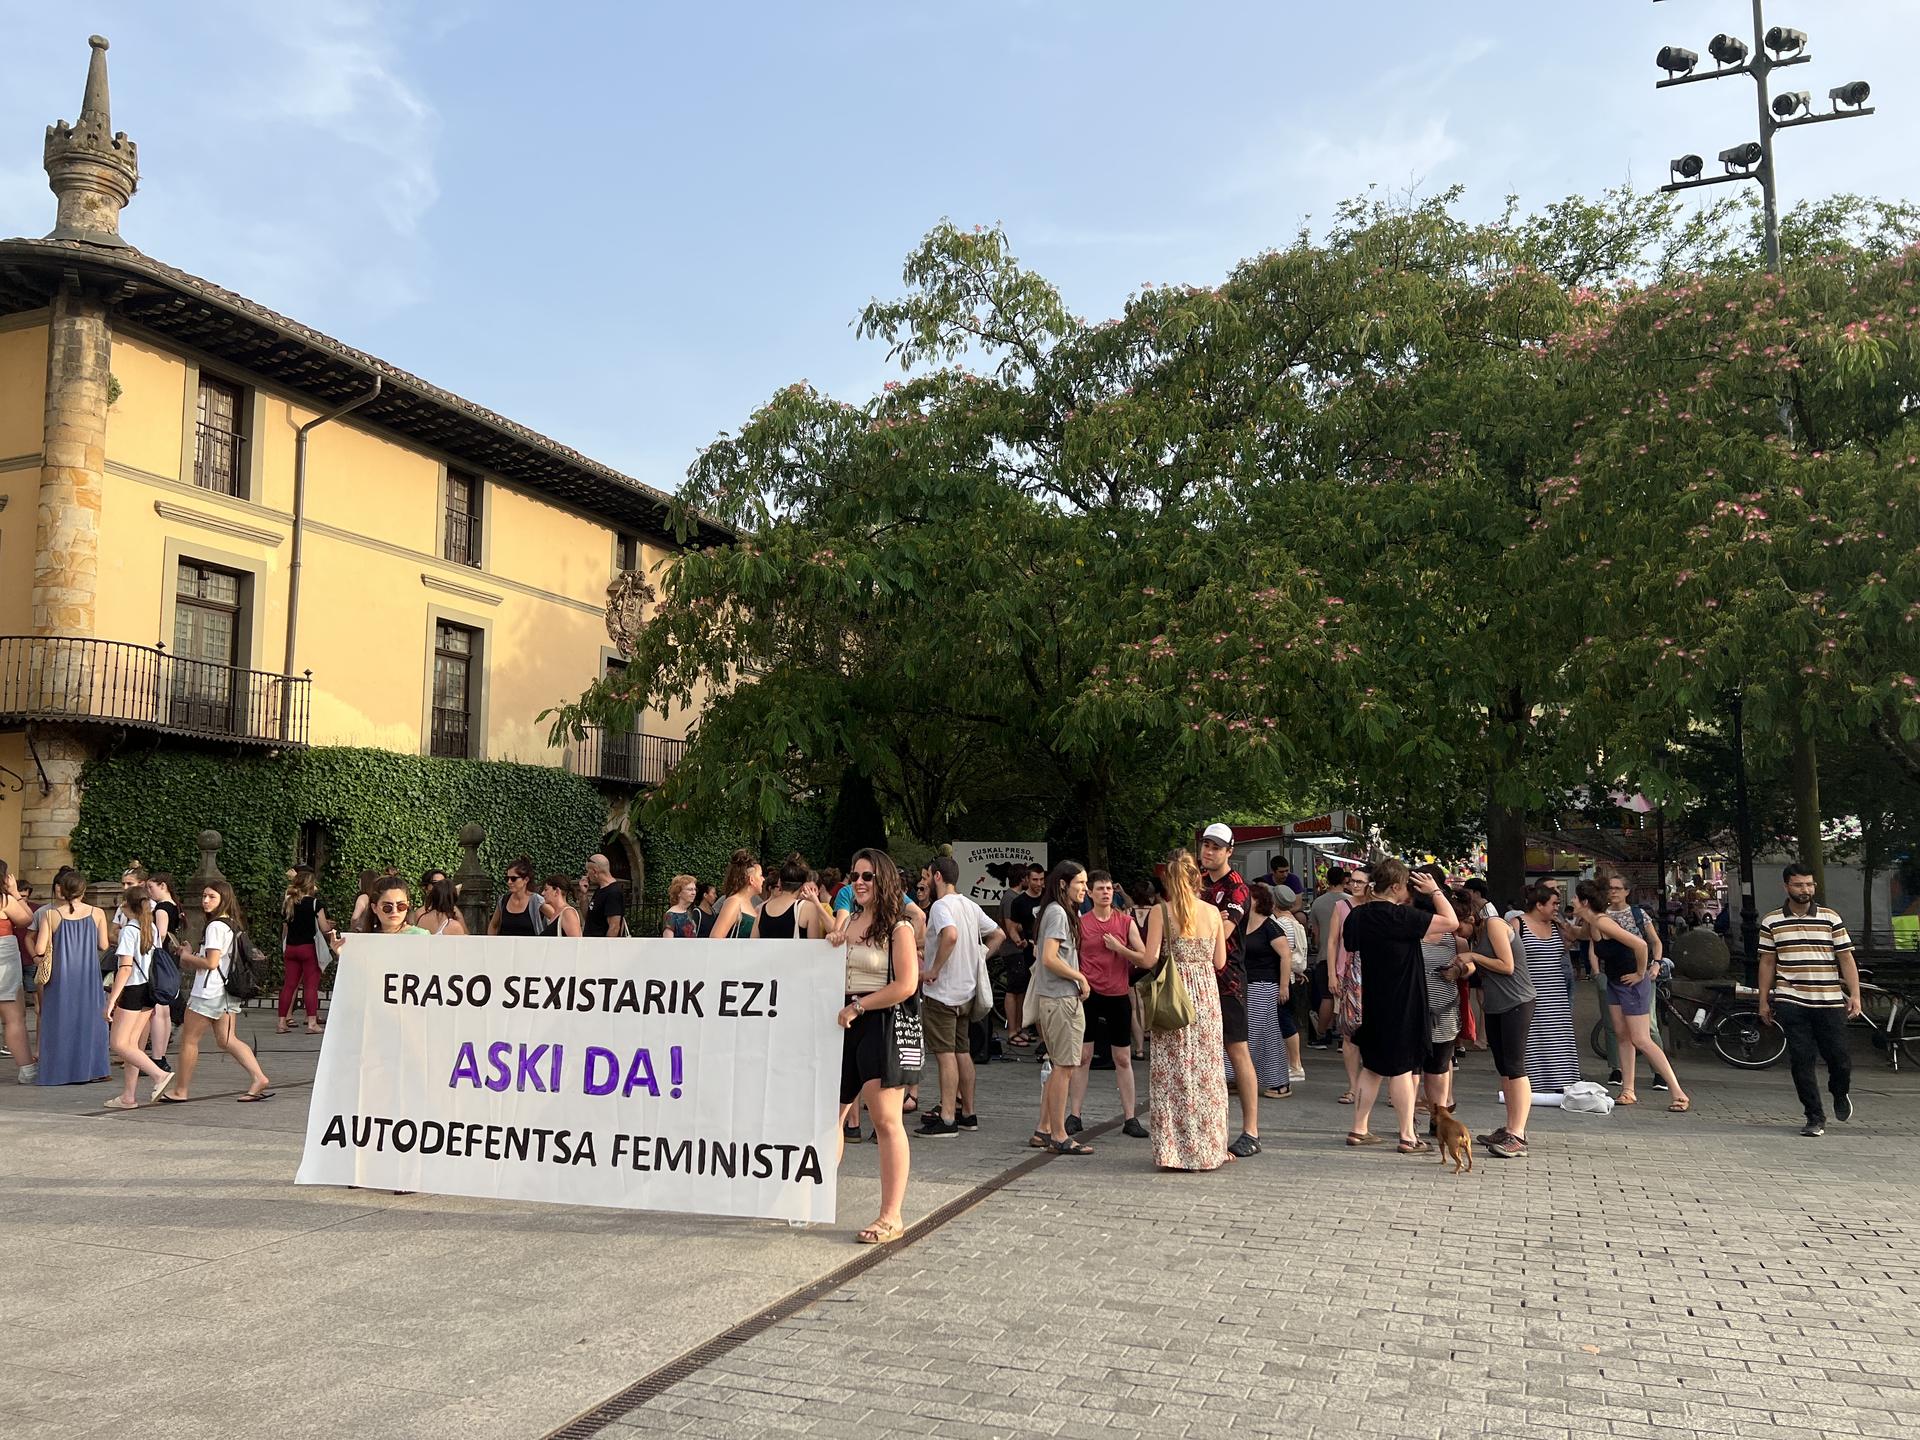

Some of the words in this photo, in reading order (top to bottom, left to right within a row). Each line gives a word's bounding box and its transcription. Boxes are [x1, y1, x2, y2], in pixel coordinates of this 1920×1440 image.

[971, 847, 1003, 856] EUSKAL
[1005, 847, 1031, 856] PRESO
[986, 853, 1035, 862] IHESLARIAK
[970, 886, 1007, 901] ETX
[383, 973, 492, 1009] ERASO
[502, 976, 706, 1018] SEXISTARIK
[718, 980, 779, 1018] EZ!
[448, 1041, 564, 1093] ASKI
[583, 1045, 684, 1100] DA!
[320, 1114, 597, 1168] AUTODEFENTSA
[611, 1134, 824, 1185] FEMINISTA
